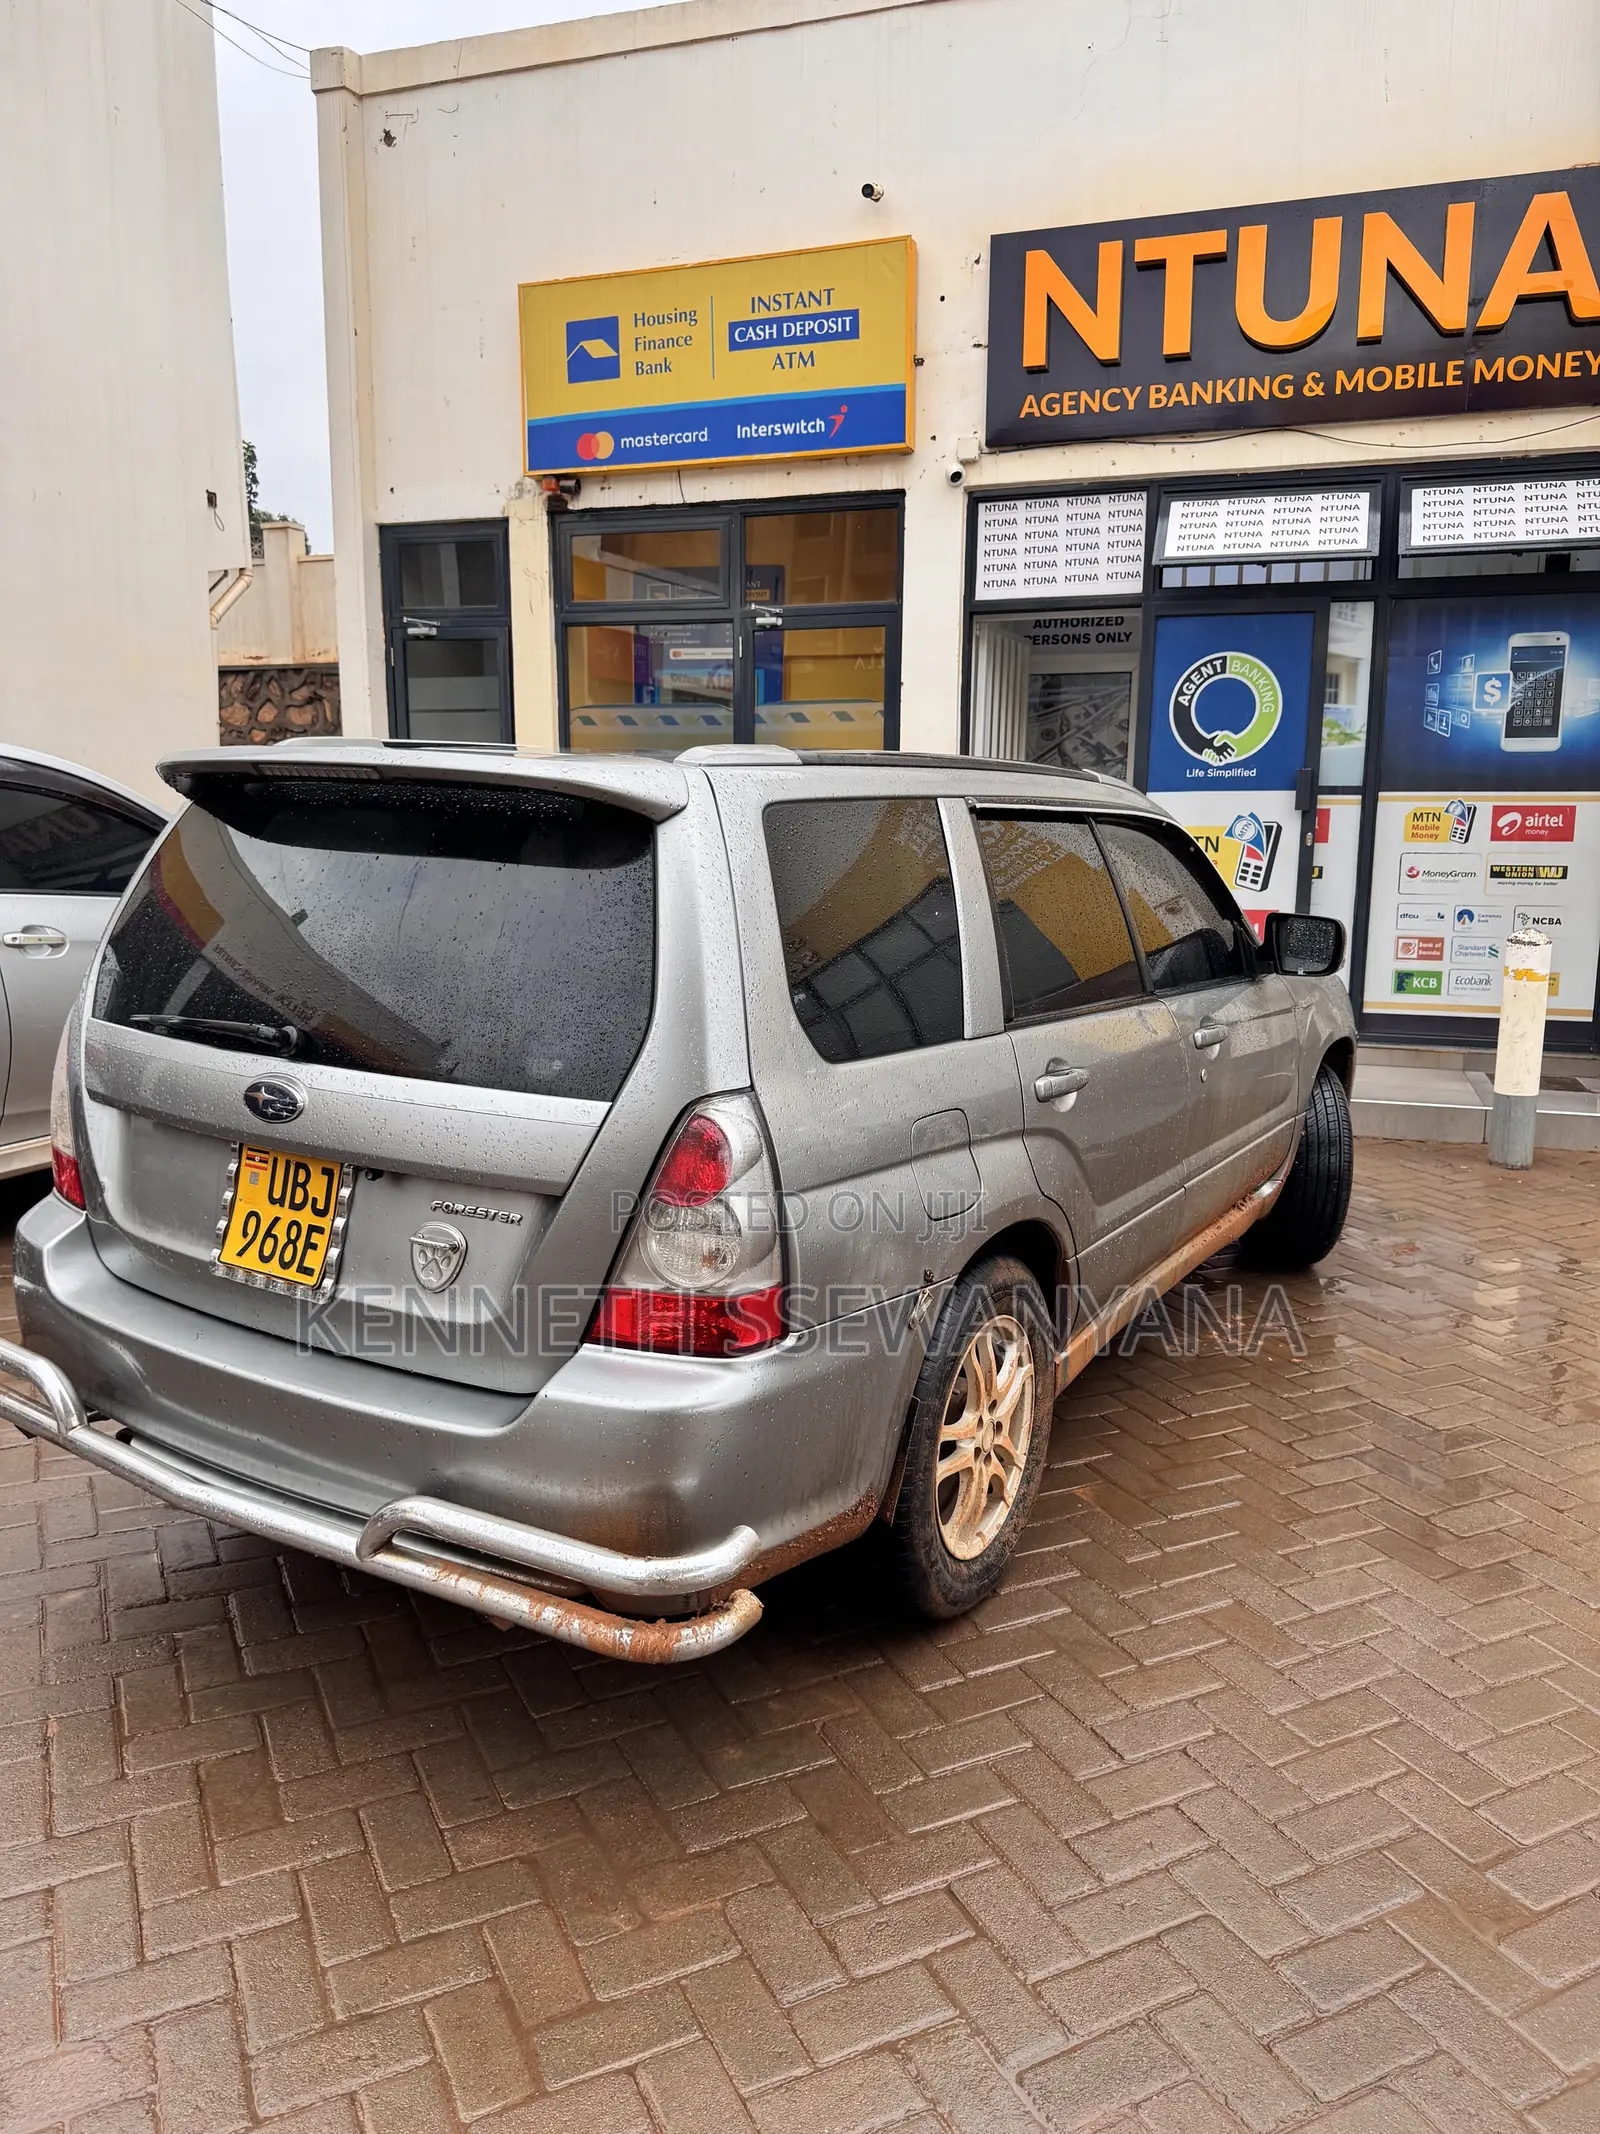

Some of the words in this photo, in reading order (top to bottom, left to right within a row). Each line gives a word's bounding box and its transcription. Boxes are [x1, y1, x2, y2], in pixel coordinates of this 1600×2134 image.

[1021, 190, 1600, 369] NTUNA
[751, 288, 835, 313] INSTANT
[634, 308, 698, 327] Housing
[734, 324, 777, 342] CASH
[783, 317, 853, 338] DEPOSIT
[635, 335, 692, 351] Finance
[636, 357, 672, 375] Bank
[772, 350, 815, 370] ATM
[1019, 386, 1142, 418] AGENCY
[1149, 374, 1294, 409] BANKING
[1302, 371, 1325, 397] &
[1335, 360, 1464, 394] MOBILE
[1473, 350, 1600, 383] MONEY
[737, 418, 825, 439] Interswitch
[621, 428, 708, 448] mastercard
[1424, 488, 1463, 496] NTUNA
[1474, 485, 1514, 493] NTUNA
[1524, 482, 1566, 490] NTUNA
[985, 503, 1017, 512] NTUNA
[1026, 500, 1059, 509] NTUNA
[1067, 497, 1100, 506] NTUNA
[1109, 493, 1143, 502] NTUNA
[985, 518, 1017, 527] NTUNA
[1025, 515, 1058, 524] NTUNA
[1067, 512, 1100, 521] NTUNA
[1109, 509, 1143, 518] NTUNA
[985, 533, 1017, 542] NTUNA
[1025, 530, 1058, 539] NTUNA
[1066, 527, 1100, 536] NTUNA
[1108, 524, 1142, 533] NTUNA
[1474, 531, 1516, 539] NTUNA
[1526, 528, 1568, 536] NTUNA
[984, 548, 1017, 557] NTUNA
[1025, 545, 1058, 554] NTUNA
[1066, 542, 1099, 551] NTUNA
[1108, 540, 1142, 549] NTUNA
[984, 563, 1016, 572] NTUNA
[1024, 560, 1057, 569] NTUNA
[1065, 558, 1099, 566] NTUNA
[1107, 555, 1141, 563] NTUNA
[984, 579, 1016, 588] NTUNA
[1024, 577, 1057, 585] NTUNA
[1065, 574, 1098, 582] NTUNA
[1107, 571, 1141, 580] NTUNA
[1033, 617, 1124, 629] AUTHORIZED
[1025, 634, 1091, 645] ERSONS
[1095, 632, 1132, 643] ONLY
[1178, 660, 1222, 706] AGENT
[1231, 660, 1275, 713] BANKING
[1186, 768, 1204, 777] Life
[1207, 768, 1256, 778] Simplified
[1412, 812, 1441, 822] MTN
[1525, 813, 1564, 827] airtel
[1238, 819, 1252, 838] MTN
[1411, 832, 1439, 840] Money
[1195, 836, 1219, 853] TN
[1422, 869, 1477, 879] MoneyGram
[1532, 917, 1562, 926] NCBA
[1413, 977, 1437, 988] KCB
[1455, 973, 1493, 986] Ecobank
[268, 1157, 335, 1218] UBJ
[430, 1199, 524, 1226] FORESTER
[235, 1211, 325, 1277] 968E
